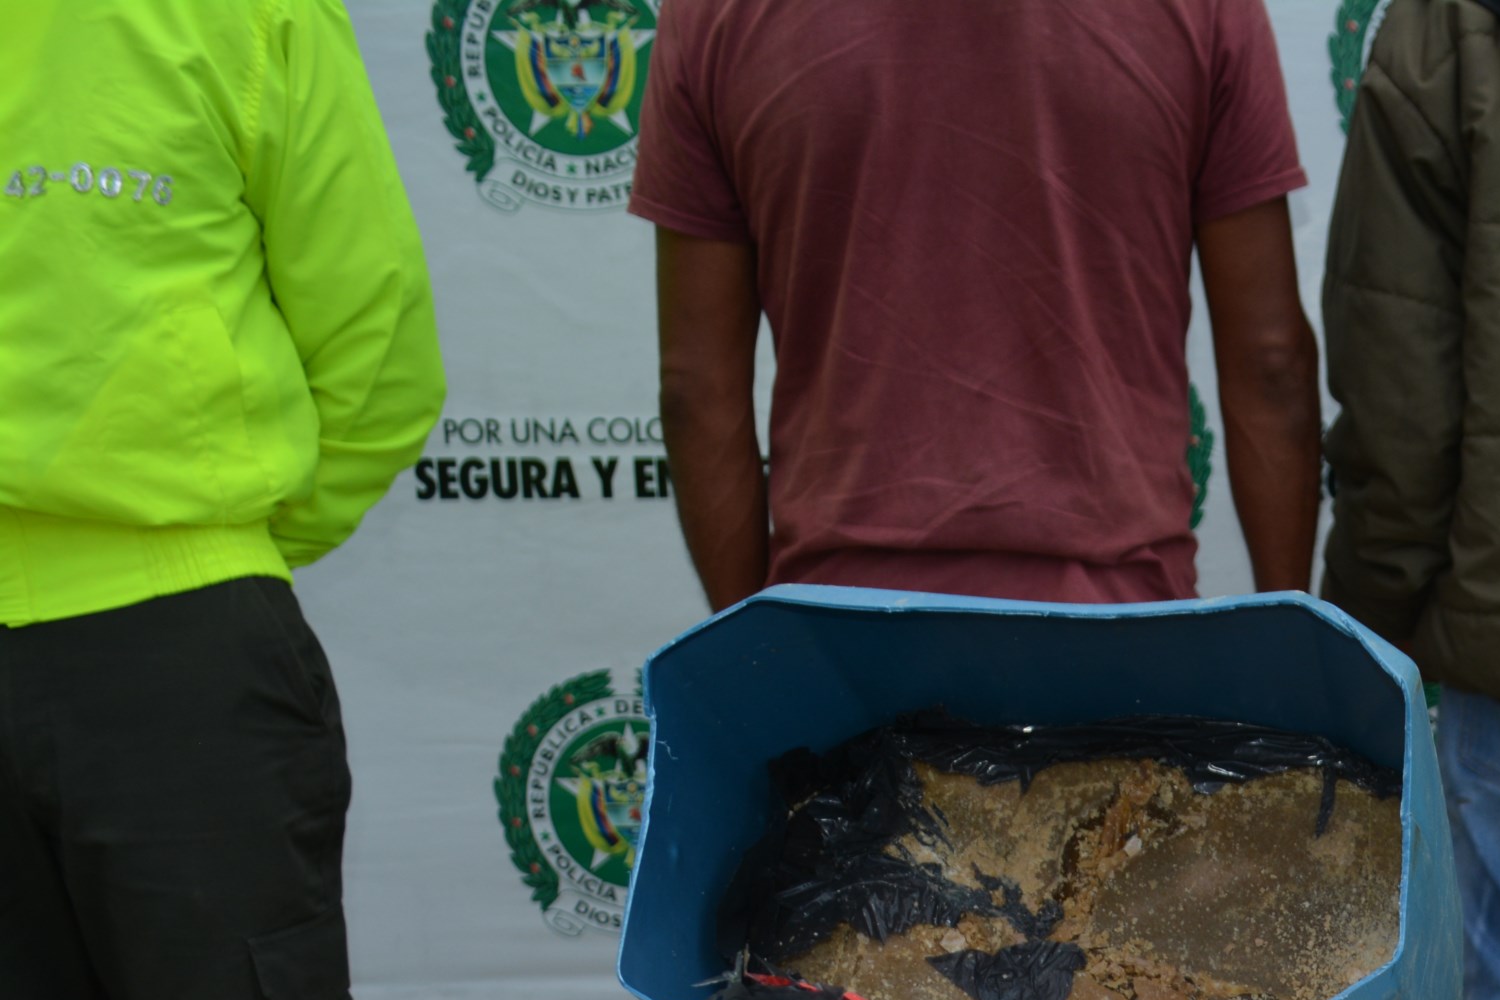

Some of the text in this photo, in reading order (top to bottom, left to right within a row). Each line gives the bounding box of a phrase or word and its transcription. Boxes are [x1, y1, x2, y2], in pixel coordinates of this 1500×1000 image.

[4, 161, 175, 206] 42-0076
[443, 418, 501, 445] POR
[511, 418, 579, 445] UNA
[415, 457, 580, 500] SEGURA
[592, 457, 618, 499] Y
